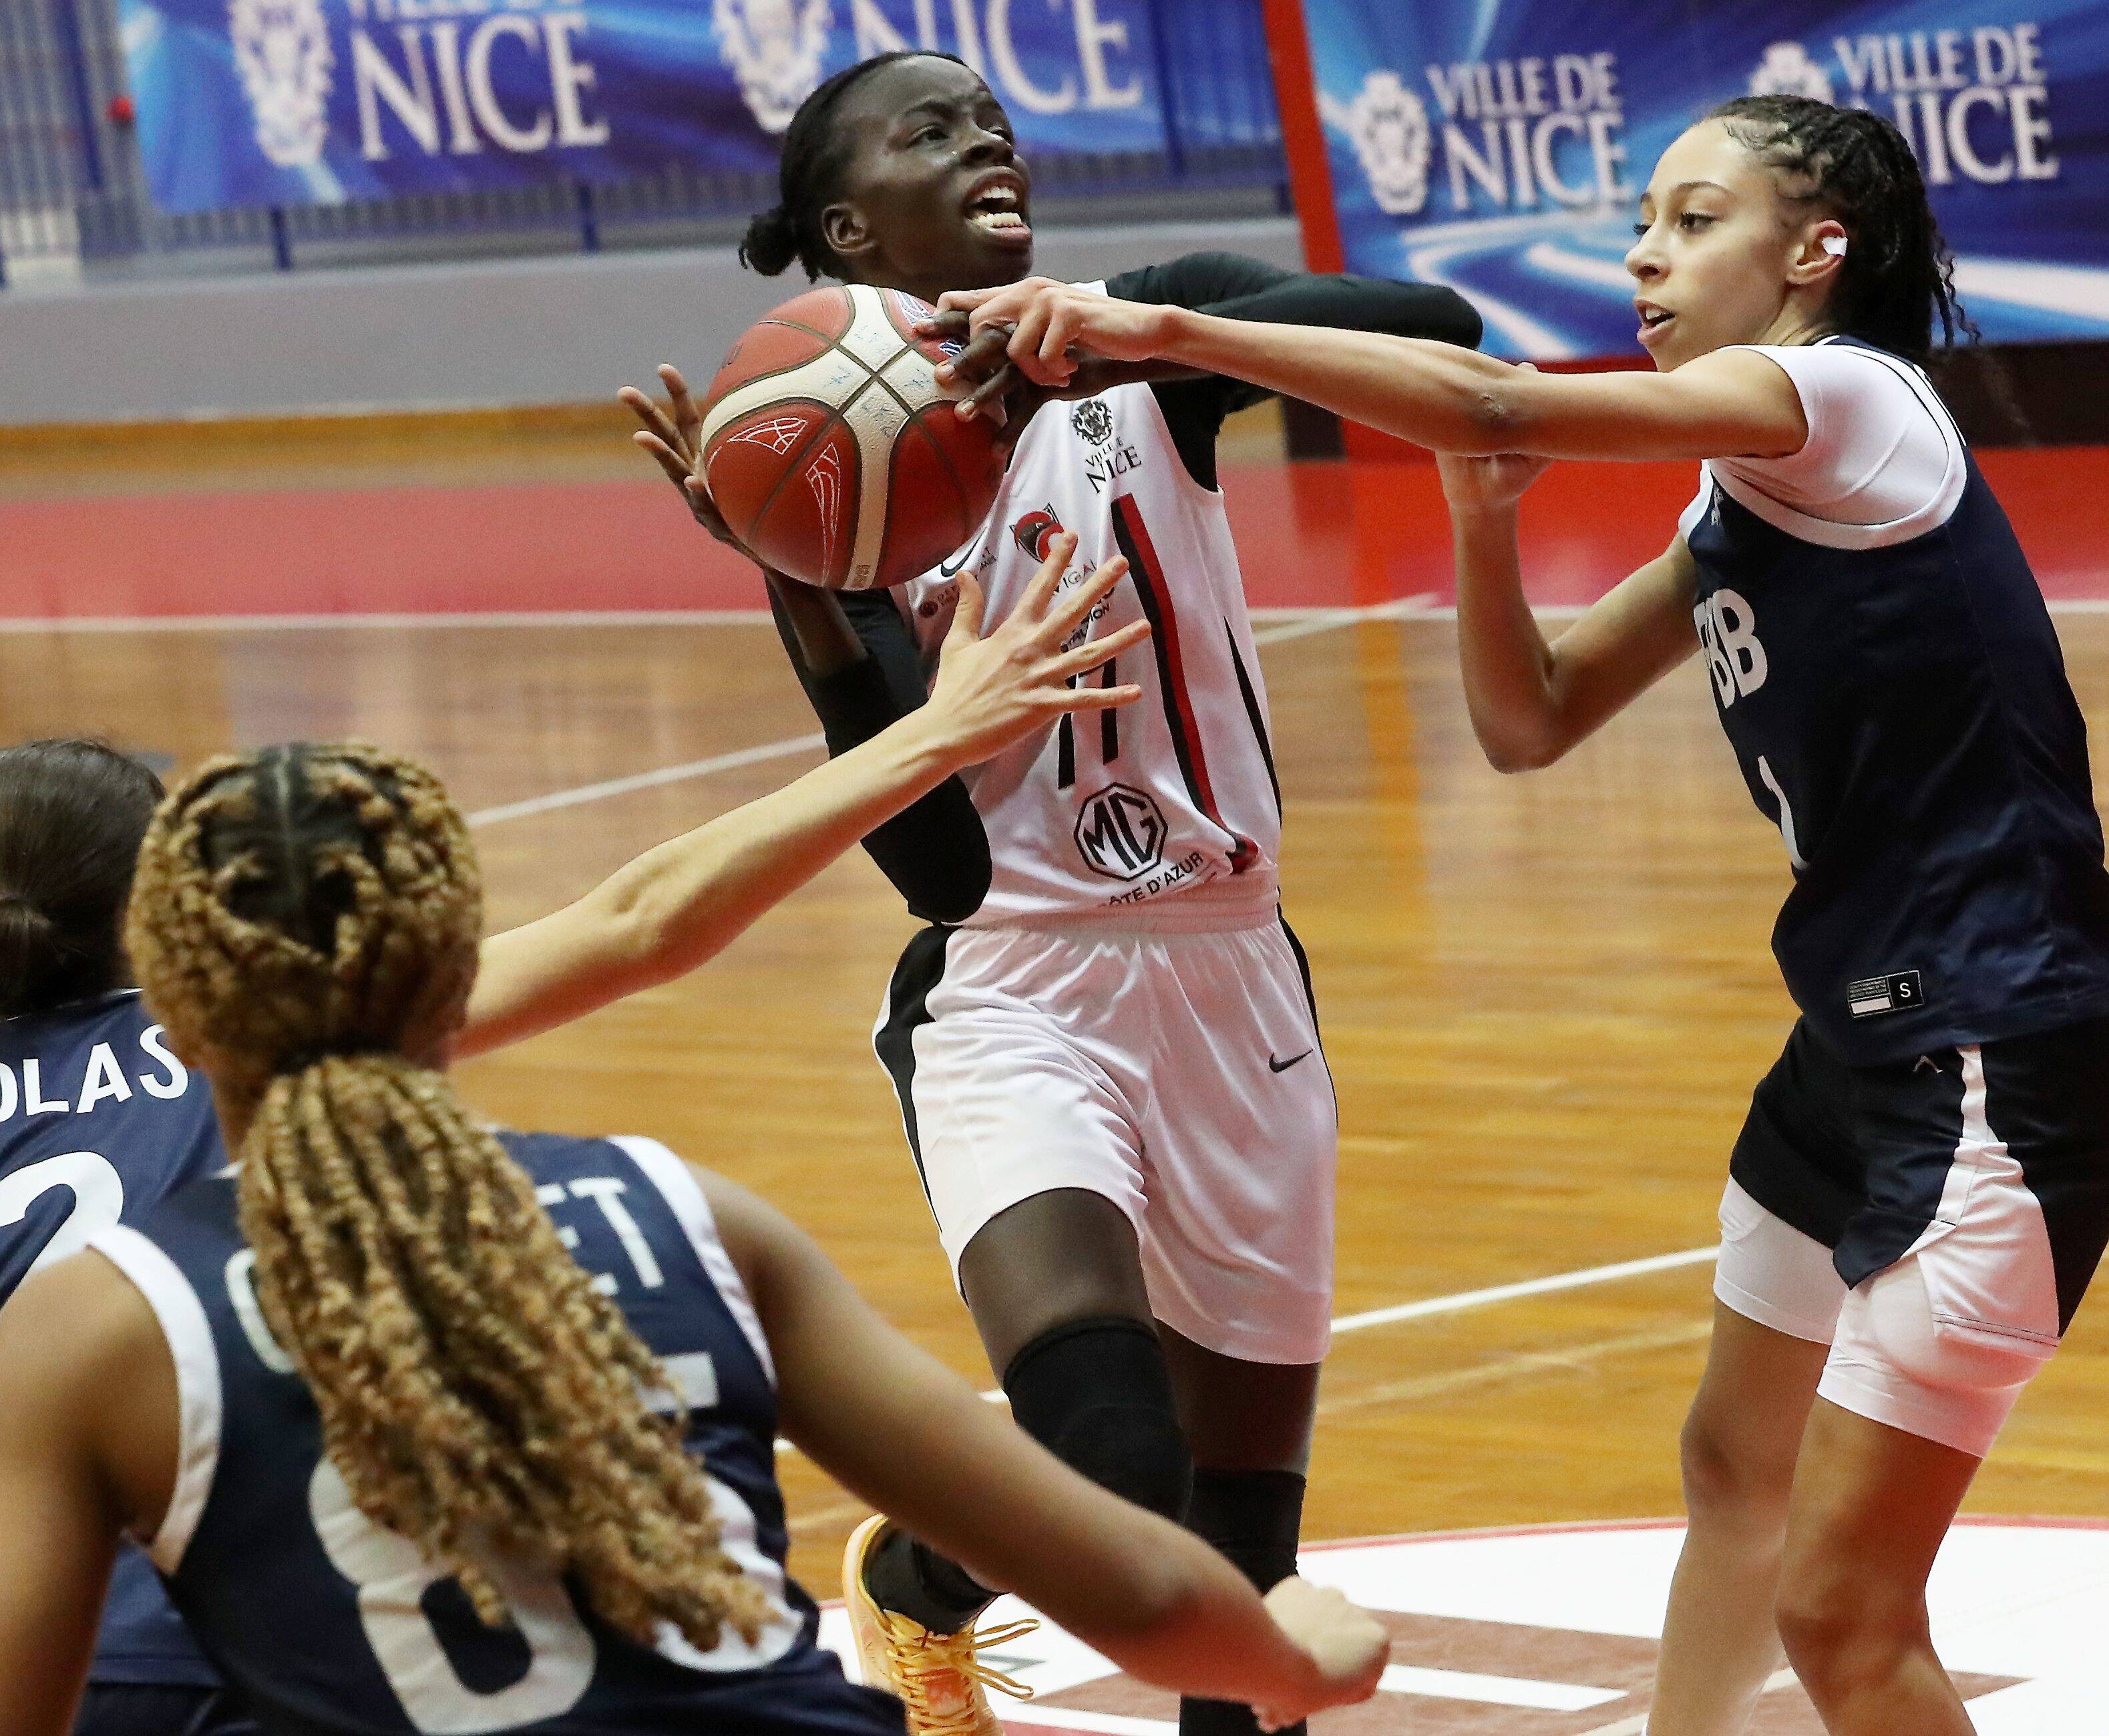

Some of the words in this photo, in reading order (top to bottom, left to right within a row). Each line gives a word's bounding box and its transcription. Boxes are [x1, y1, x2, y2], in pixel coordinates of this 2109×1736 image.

[350, 12, 610, 162] NICE
[1425, 55, 1551, 118] VILLE
[1553, 51, 1623, 112] DE
[1833, 29, 1969, 93] VILLE
[1973, 23, 2048, 85] DE
[1443, 111, 1639, 210] NICE
[1085, 445, 1142, 494] NICE
[1083, 792, 1158, 871] MG
[1146, 851, 1203, 895] D'AZUR
[1899, 983, 1911, 998] S
